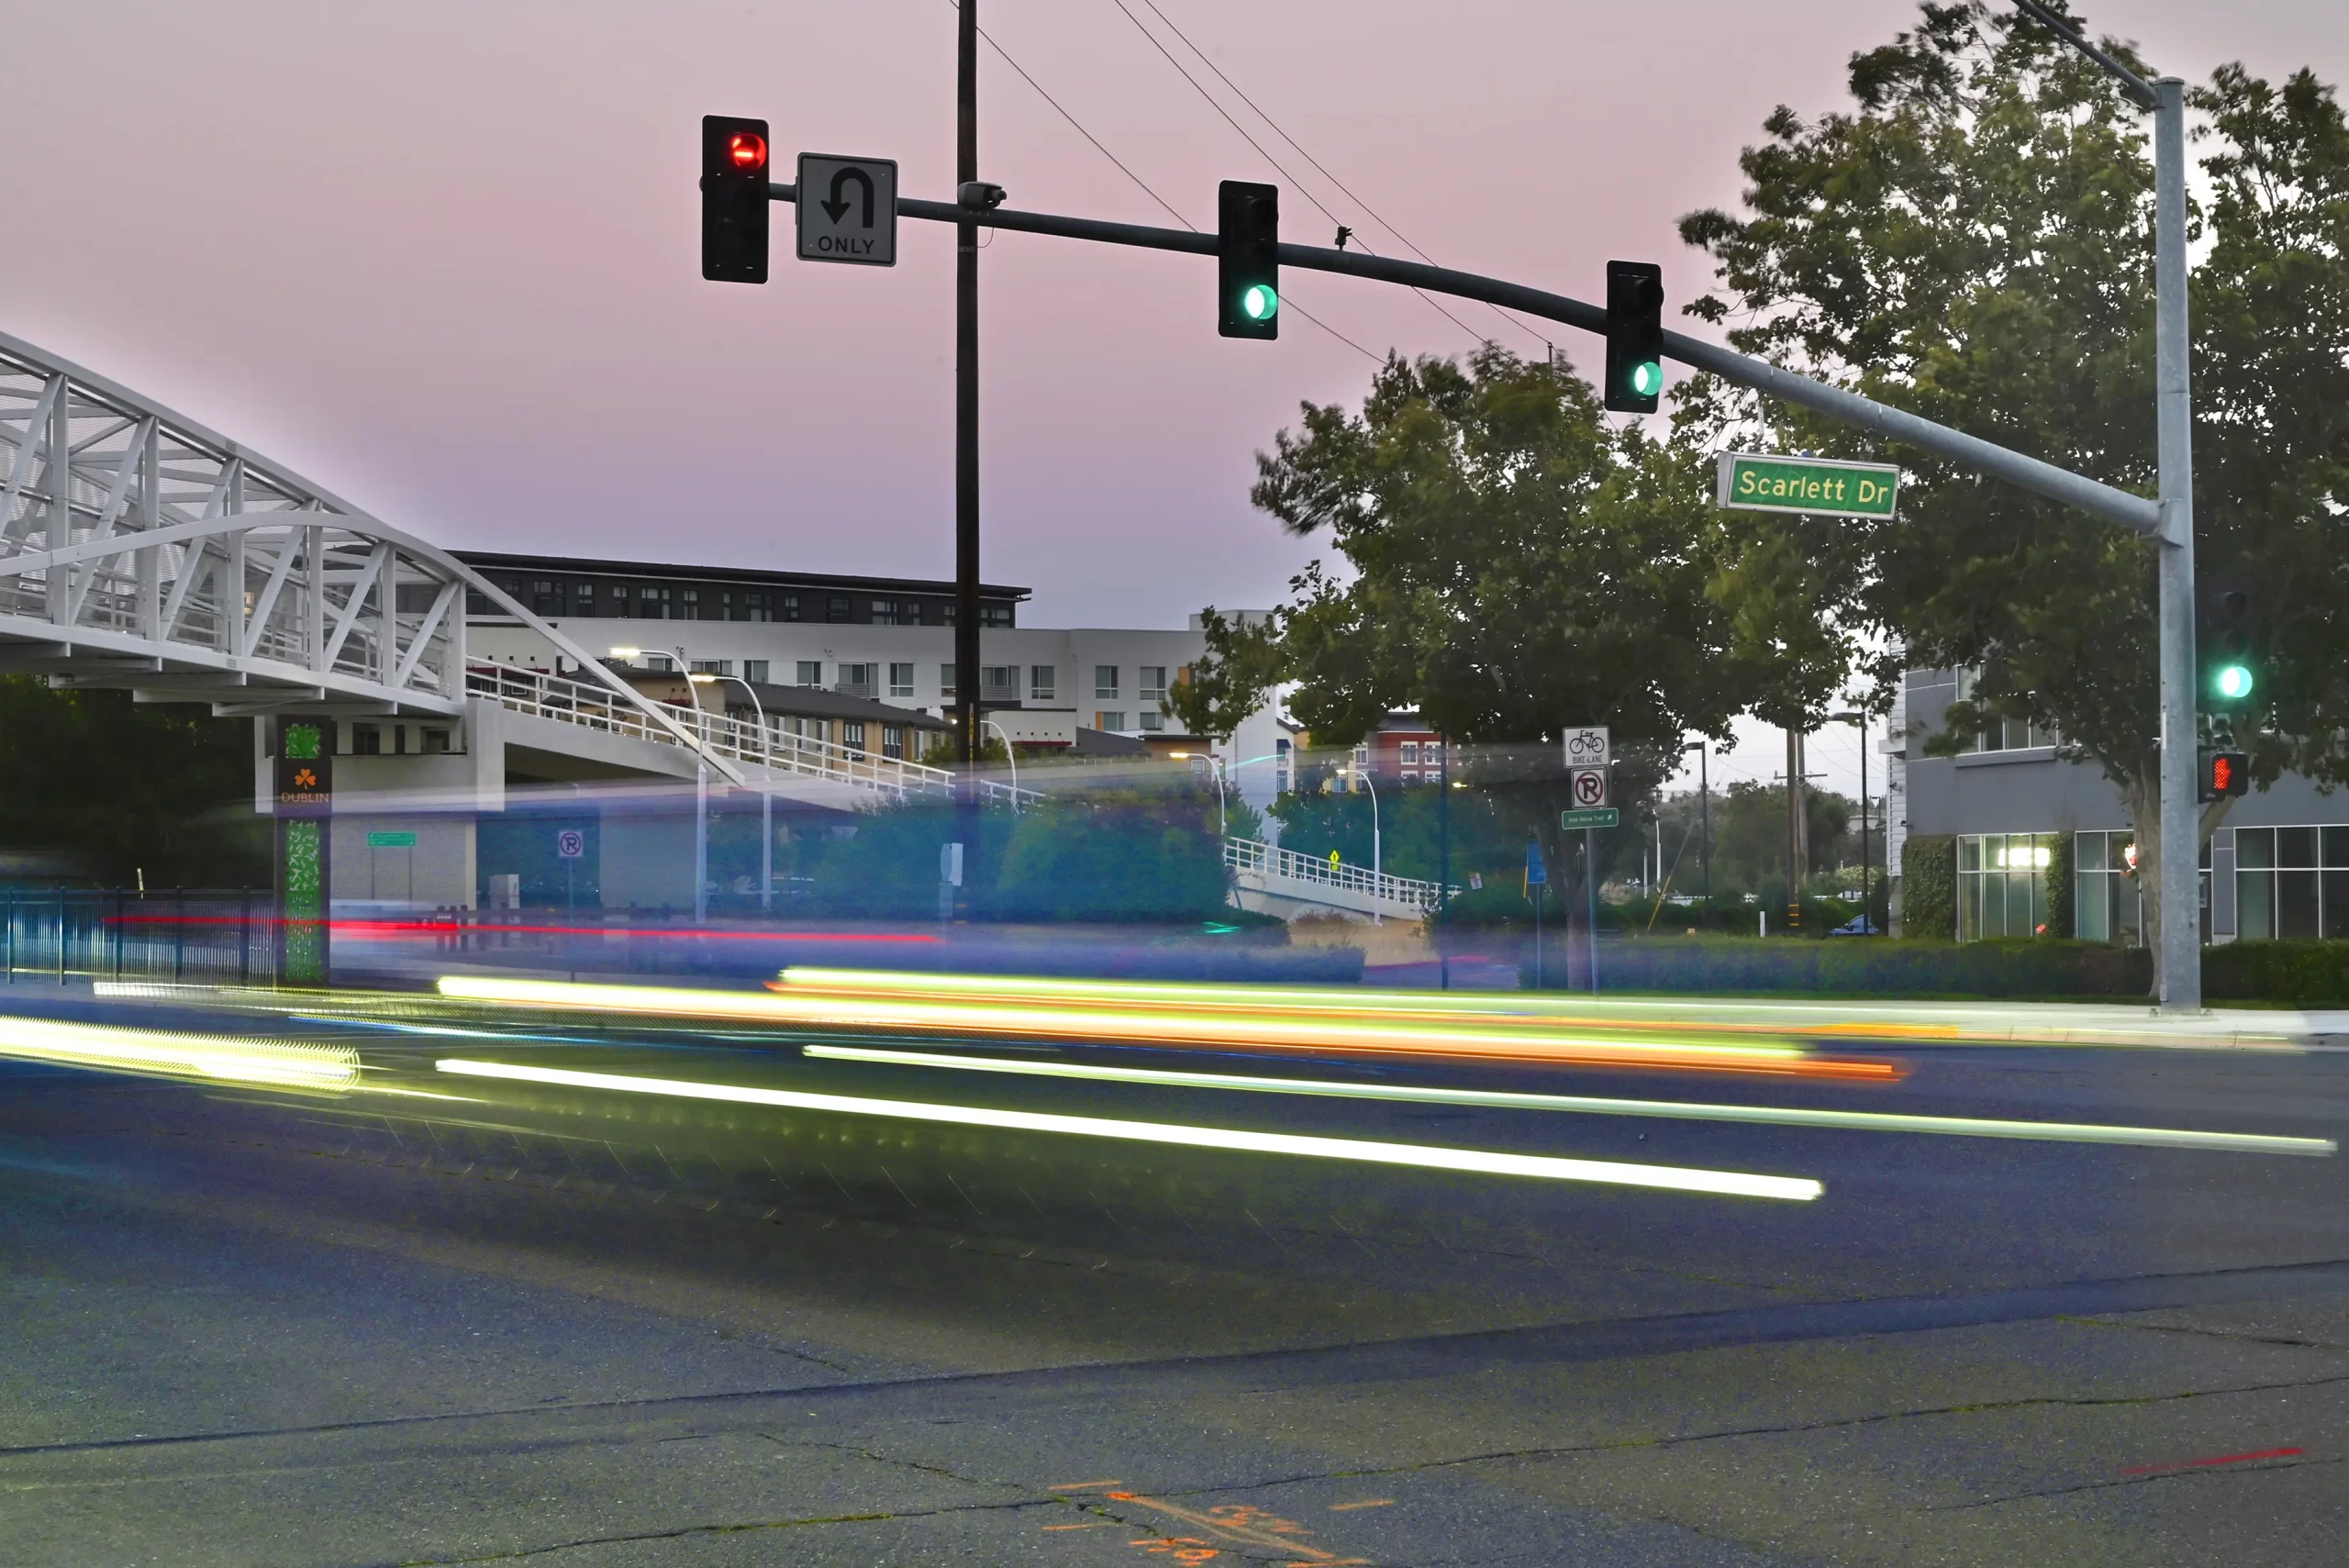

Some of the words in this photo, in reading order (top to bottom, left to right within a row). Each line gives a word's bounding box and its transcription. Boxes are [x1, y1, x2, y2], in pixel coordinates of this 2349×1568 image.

[818, 236, 874, 254] ONLY
[1739, 471, 1845, 501] Scarlett
[1858, 480, 1888, 504] Dr
[1587, 755, 1602, 763] LANE
[281, 792, 329, 803] DUBLIN
